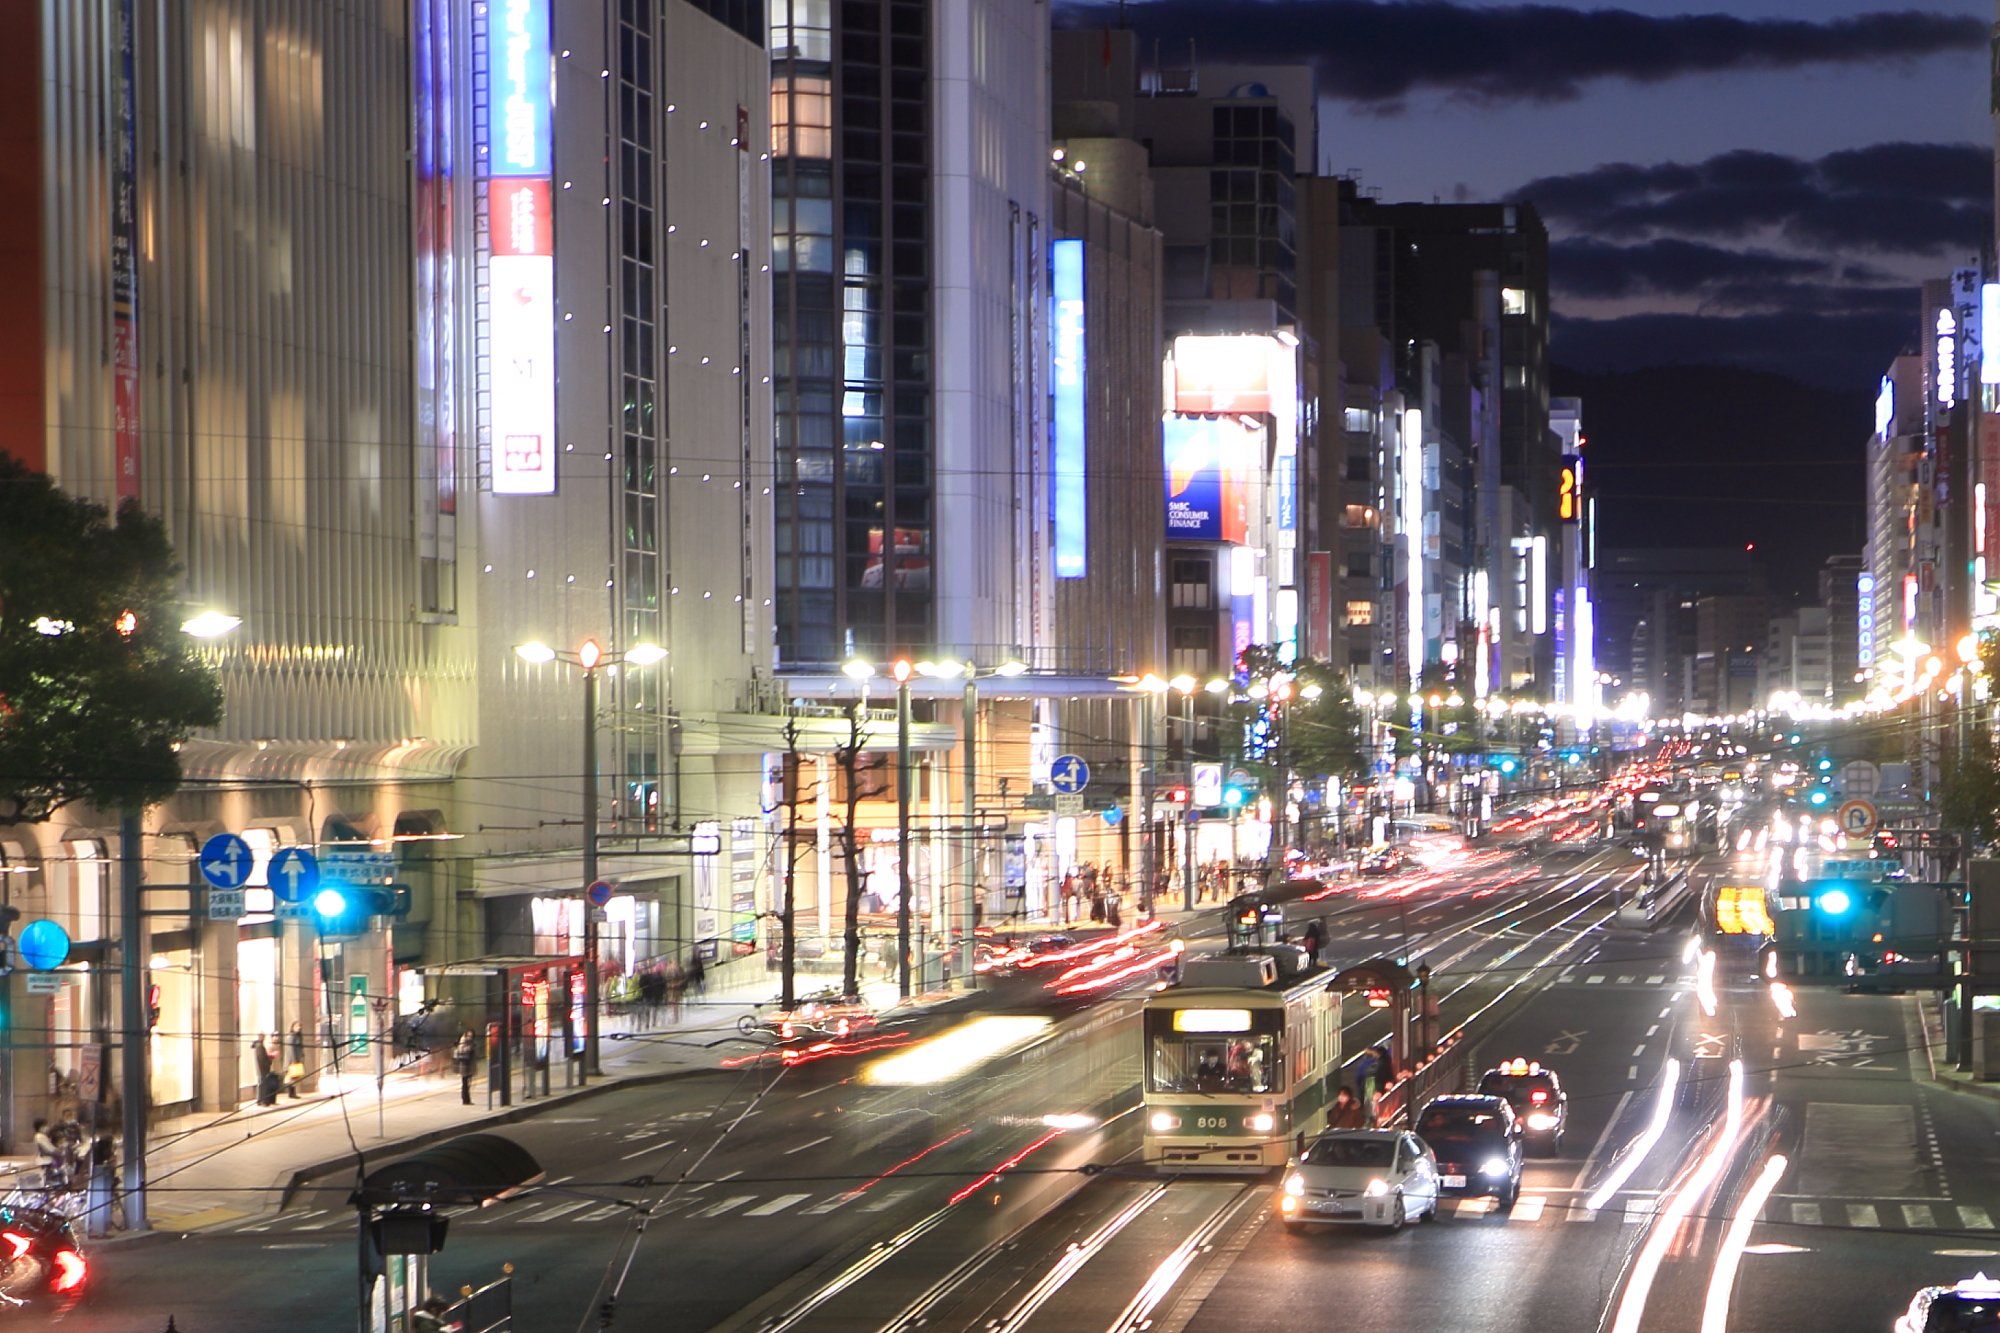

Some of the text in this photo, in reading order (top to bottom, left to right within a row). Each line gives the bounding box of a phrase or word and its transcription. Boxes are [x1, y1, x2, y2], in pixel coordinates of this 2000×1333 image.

[1168, 502, 1190, 511] SMBC
[1168, 511, 1209, 520] CONSUMER
[1168, 519, 1201, 528] FINANCE
[1197, 1116, 1227, 1129] 808
